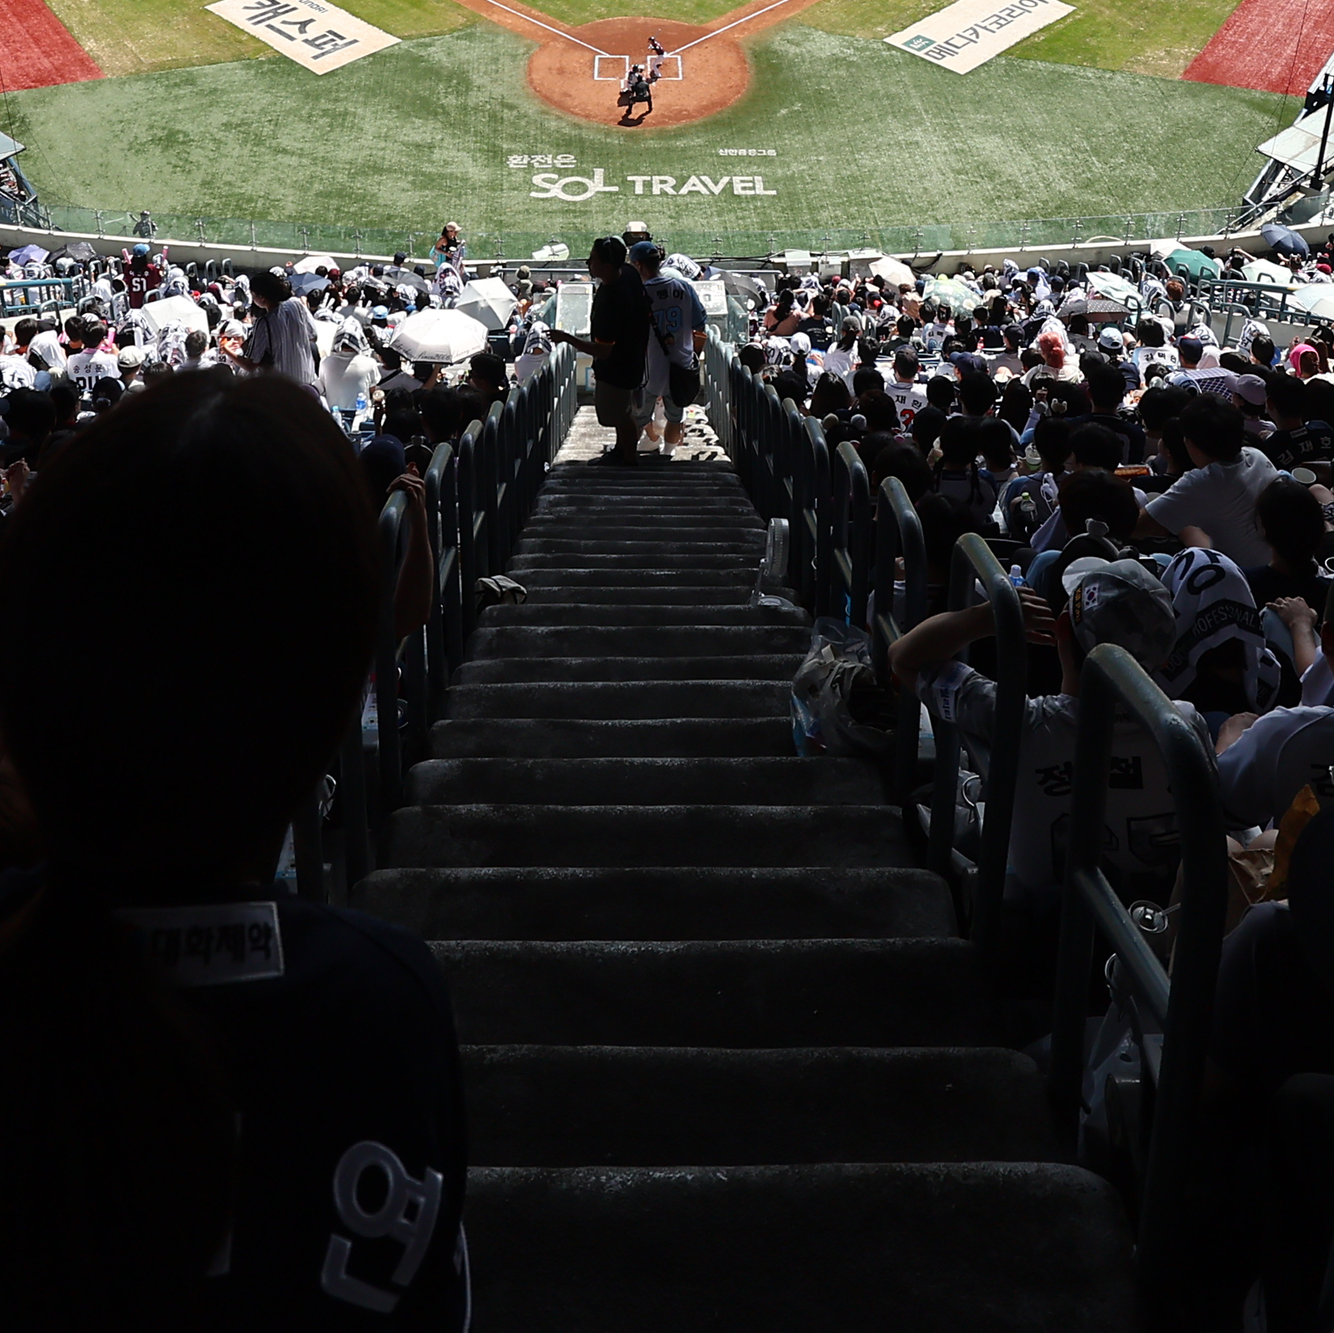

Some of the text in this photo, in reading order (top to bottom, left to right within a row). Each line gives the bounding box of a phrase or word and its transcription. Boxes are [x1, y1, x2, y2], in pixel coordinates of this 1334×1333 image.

[506, 153, 577, 168] 환전은
[529, 167, 778, 202] SOL TRAVEL
[1277, 436, 1333, 466] 김재호
[150, 923, 272, 965] 대화제약
[320, 1139, 445, 1315] 연
